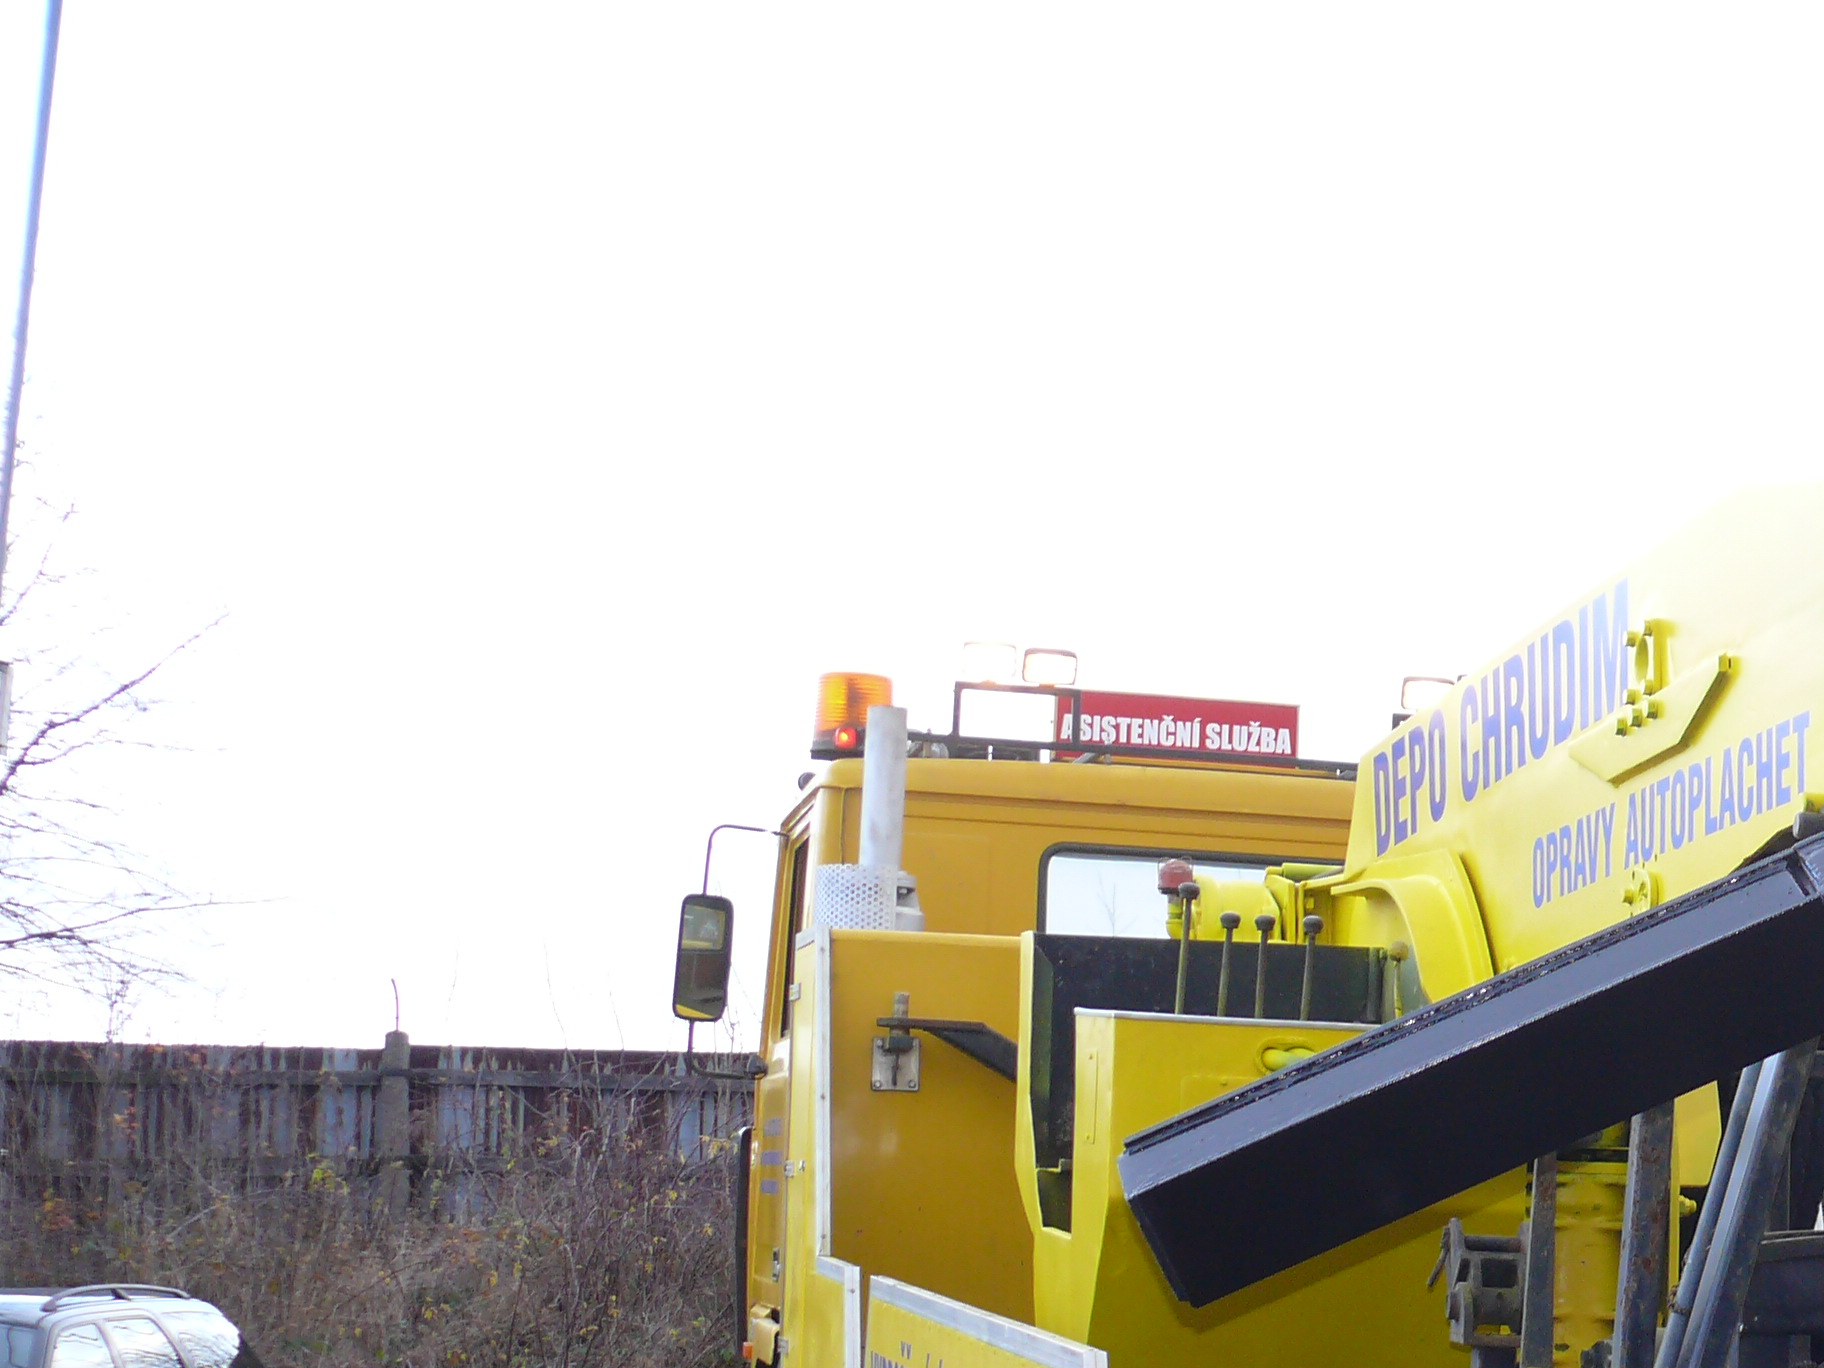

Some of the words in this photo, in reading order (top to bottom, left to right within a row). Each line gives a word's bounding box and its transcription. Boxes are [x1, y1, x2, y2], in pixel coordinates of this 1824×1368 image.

[1060, 713, 1203, 749] ASISTENČNÍ
[1206, 720, 1292, 755] SLUŽBA
[1372, 708, 1448, 858] DEPO
[1460, 577, 1629, 803] CHRUDIM
[1532, 802, 1616, 910] OPRAVY
[1623, 710, 1811, 870] AUTOPLACHET
